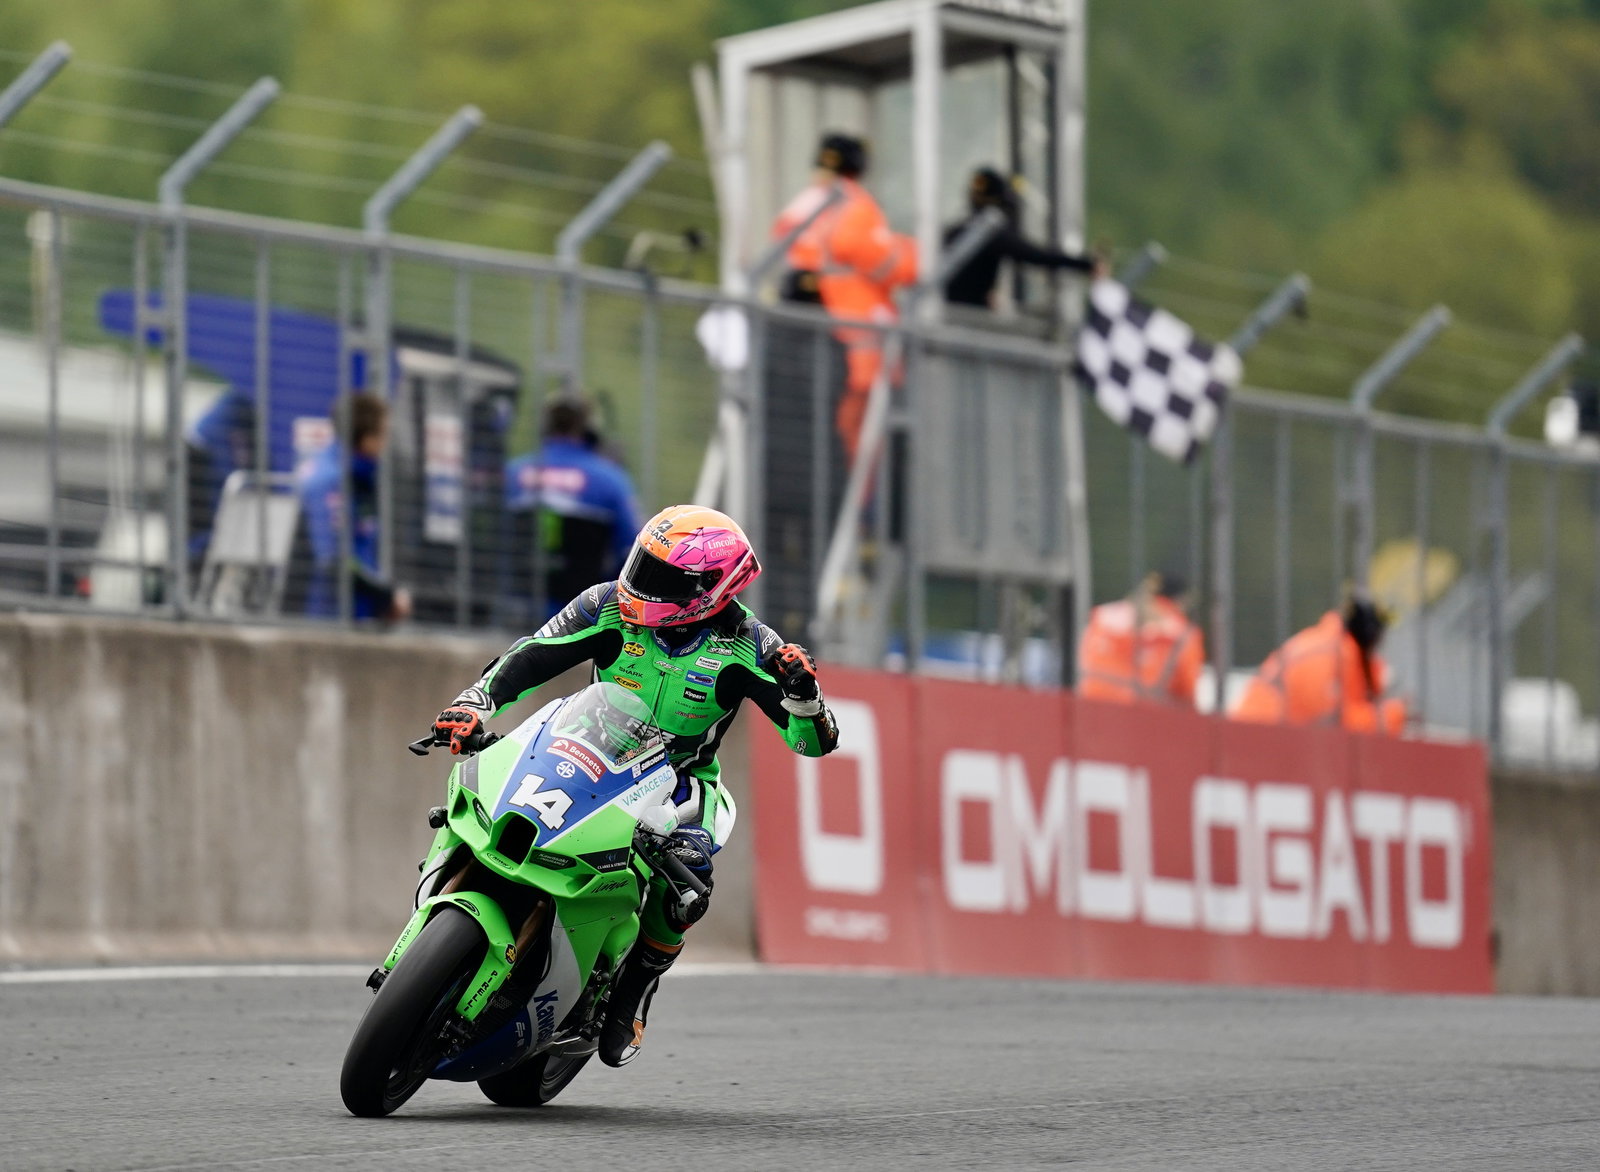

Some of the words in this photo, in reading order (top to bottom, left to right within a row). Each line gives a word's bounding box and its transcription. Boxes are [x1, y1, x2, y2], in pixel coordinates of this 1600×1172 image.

[646, 525, 673, 548] SHARK
[707, 537, 737, 549] Lincoln
[710, 548, 735, 559] College
[619, 667, 643, 678] SHARK
[568, 745, 602, 775] Bennetts
[508, 773, 575, 831] 14
[942, 749, 1464, 948] OMOLOGATO
[464, 970, 498, 1012] PIRELLI
